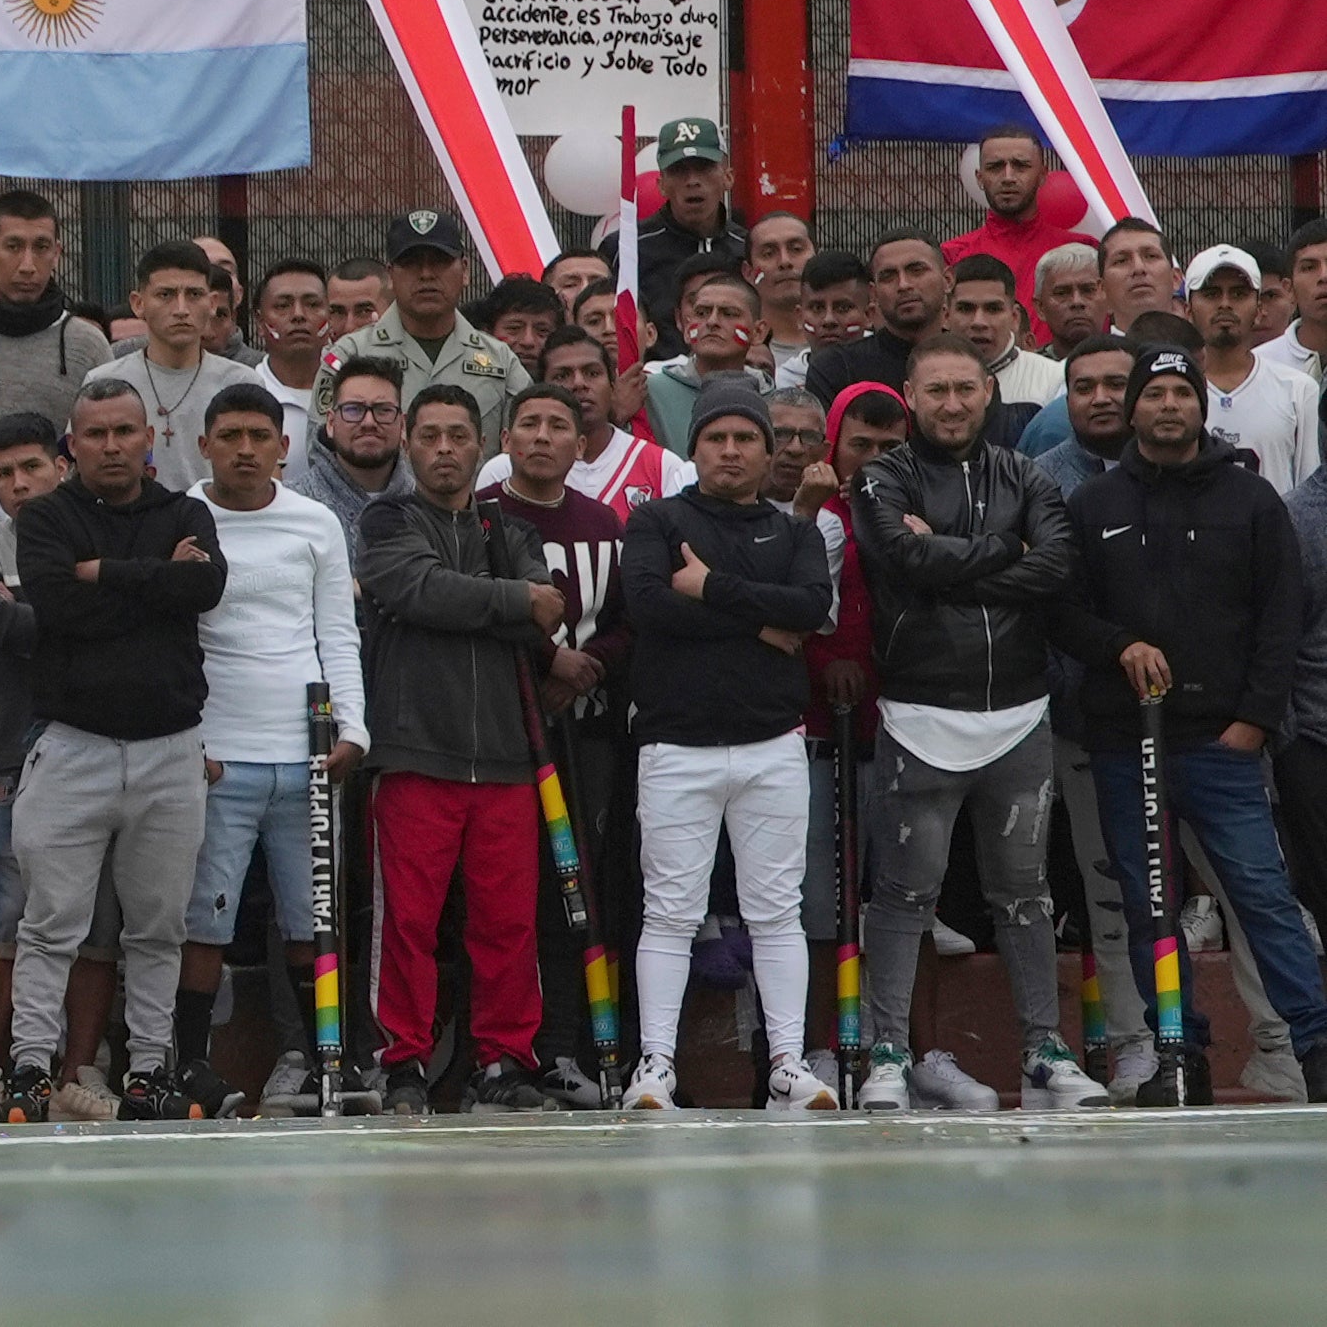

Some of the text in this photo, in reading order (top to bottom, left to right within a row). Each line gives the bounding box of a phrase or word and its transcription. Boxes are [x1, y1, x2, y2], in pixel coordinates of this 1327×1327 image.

[577, 8, 601, 25] es
[680, 4, 718, 29] duro,
[581, 56, 594, 79] y
[660, 55, 707, 77] Todo
[496, 76, 541, 97] mor
[1158, 353, 1184, 364] NIKE
